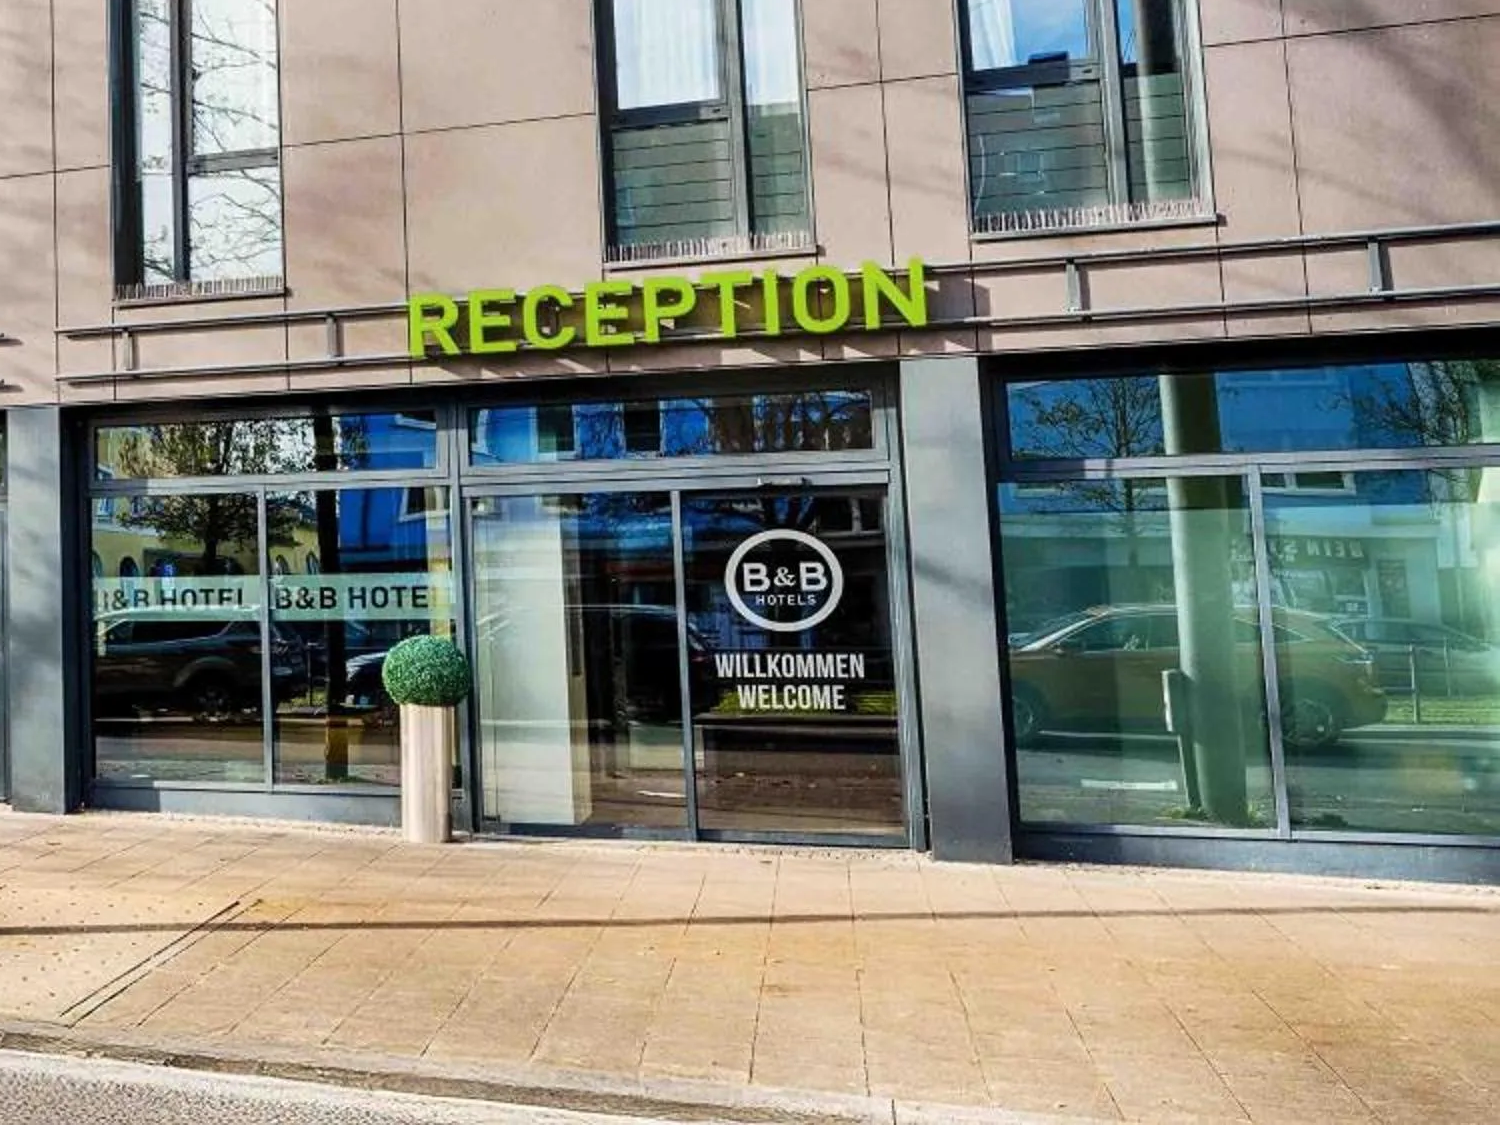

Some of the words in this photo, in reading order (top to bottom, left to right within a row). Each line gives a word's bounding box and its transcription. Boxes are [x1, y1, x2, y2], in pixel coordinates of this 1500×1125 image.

[407, 257, 929, 359] RECEPTION
[743, 561, 828, 592] B&B
[276, 587, 337, 610] B&B
[755, 594, 817, 606] HOTELS
[715, 653, 865, 679] WILLKOMMEN
[737, 684, 846, 710] WELCOME
